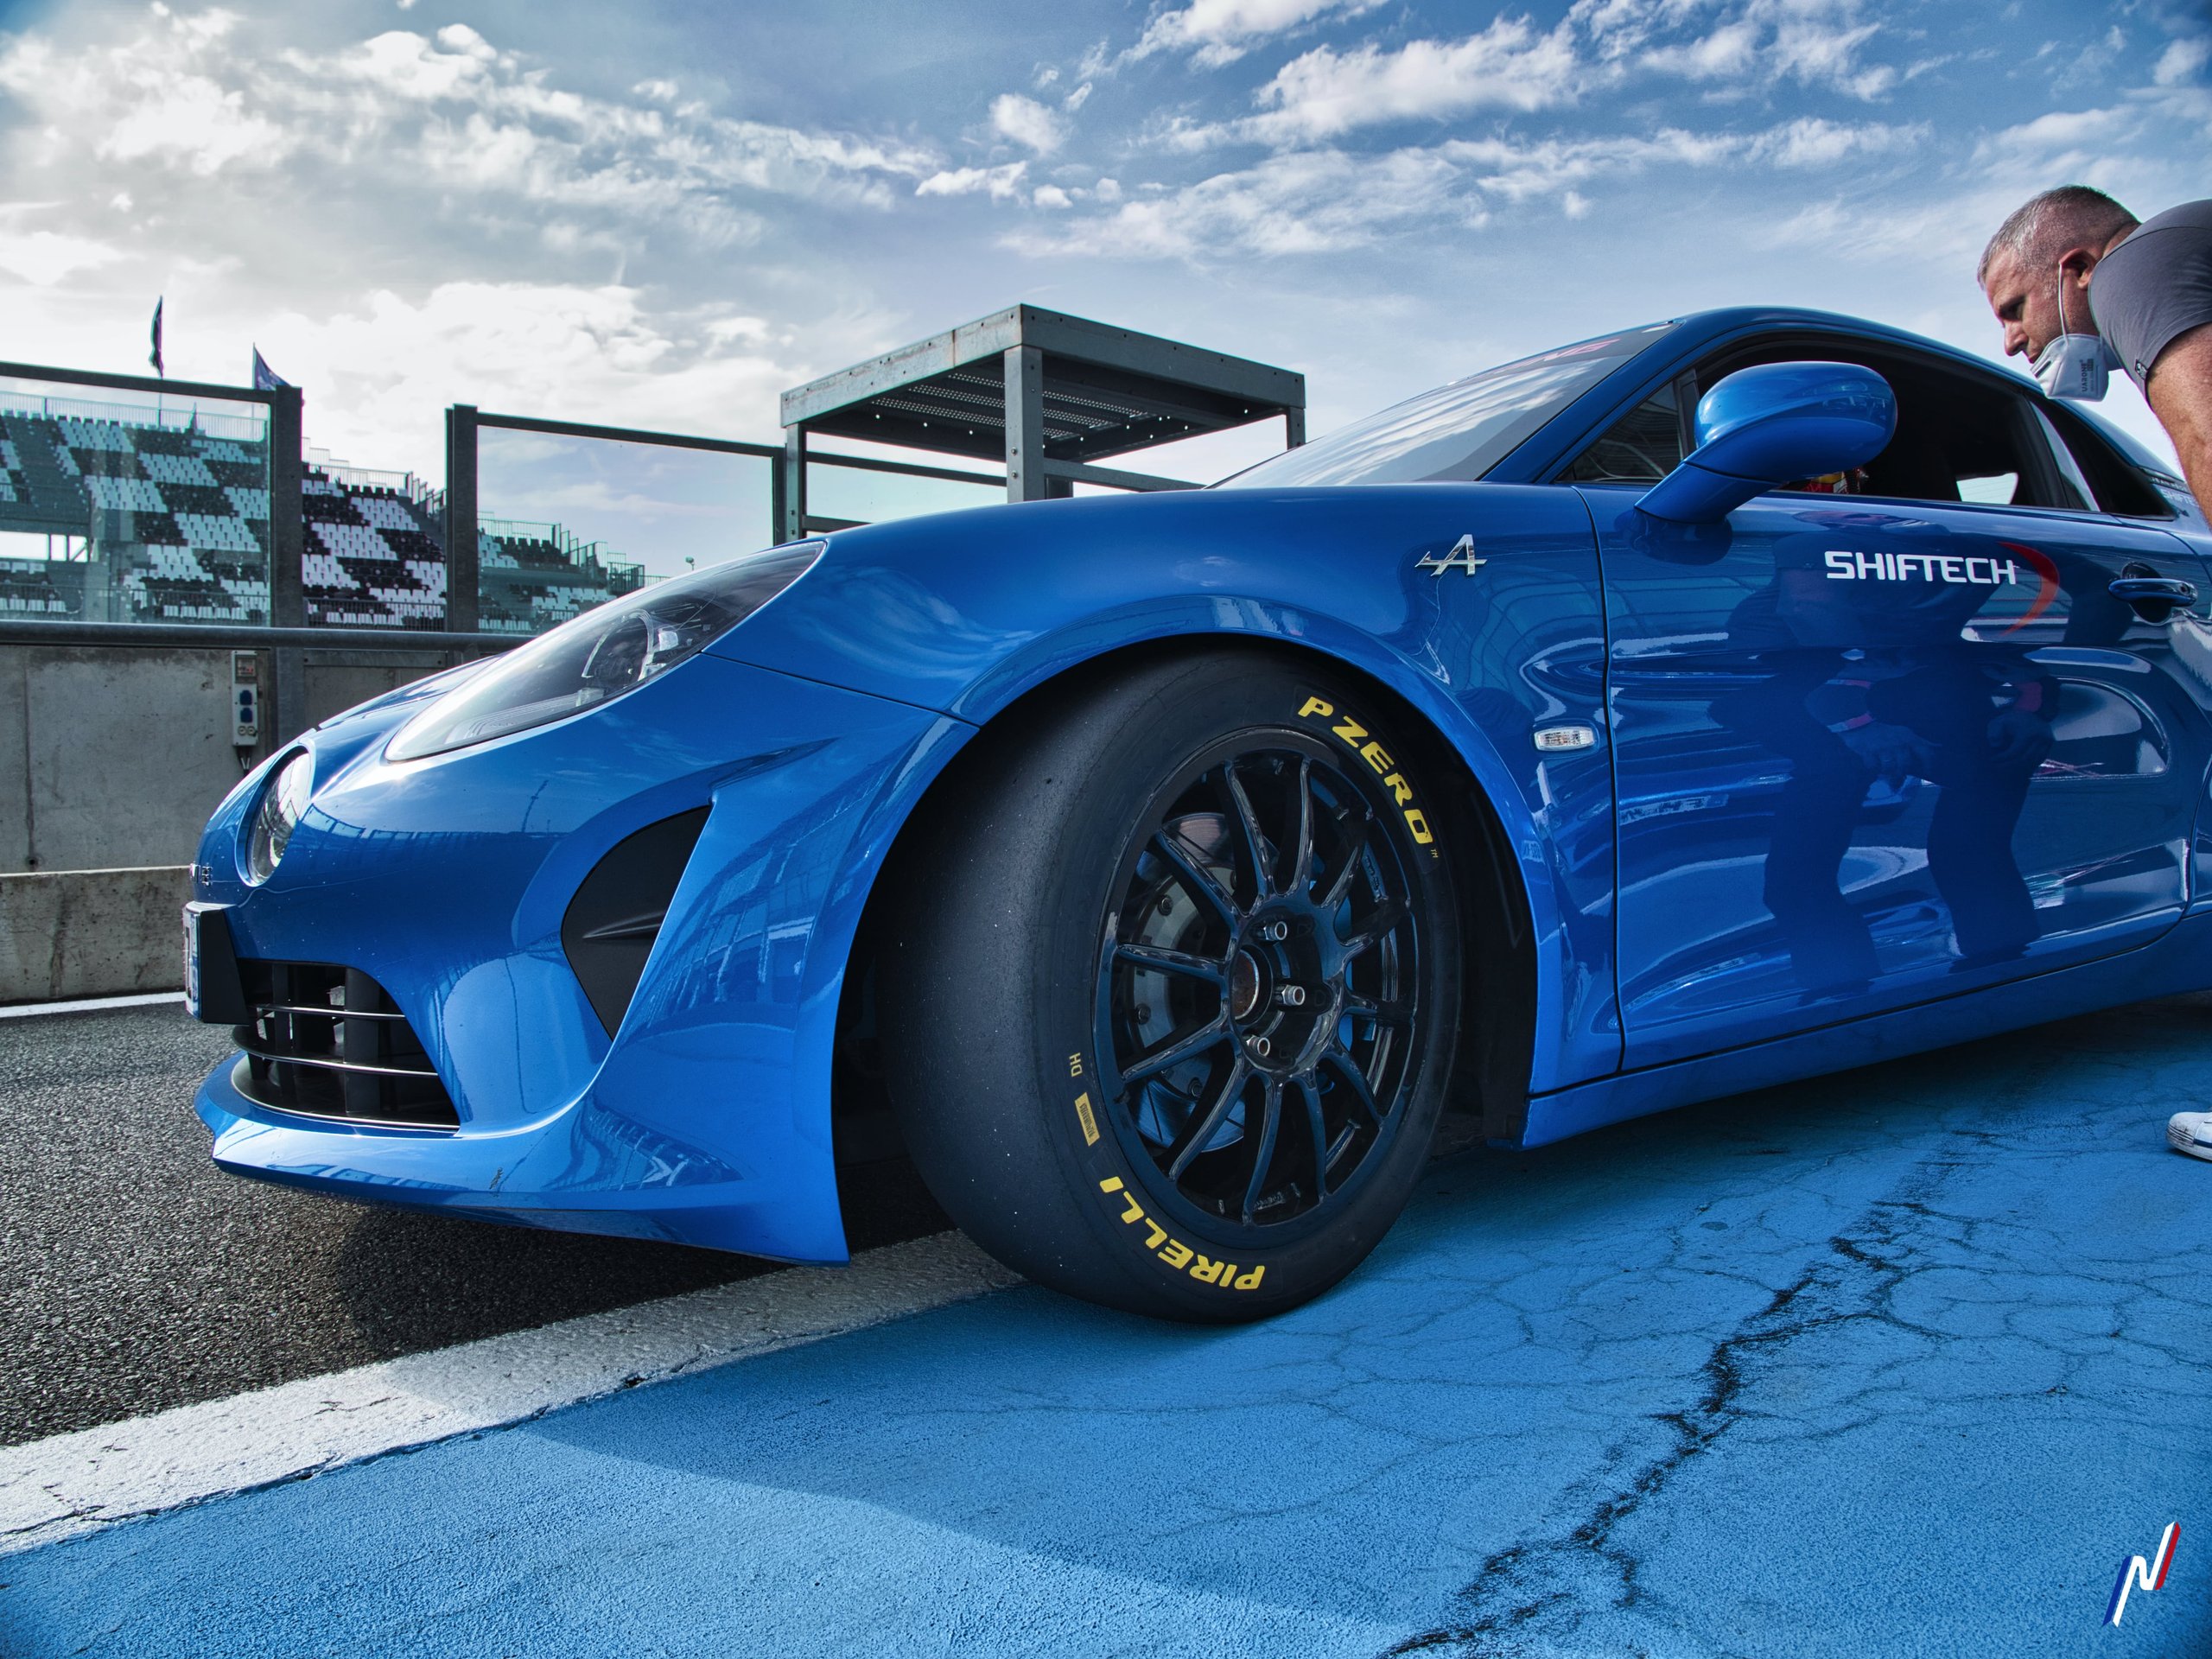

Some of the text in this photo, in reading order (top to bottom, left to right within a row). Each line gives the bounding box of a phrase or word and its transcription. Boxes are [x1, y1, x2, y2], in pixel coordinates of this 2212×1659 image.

[1824, 550, 2017, 585] SHIFTECH
[1069, 1052, 1084, 1077] DH
[1099, 1176, 1265, 1290] PIRELLI
